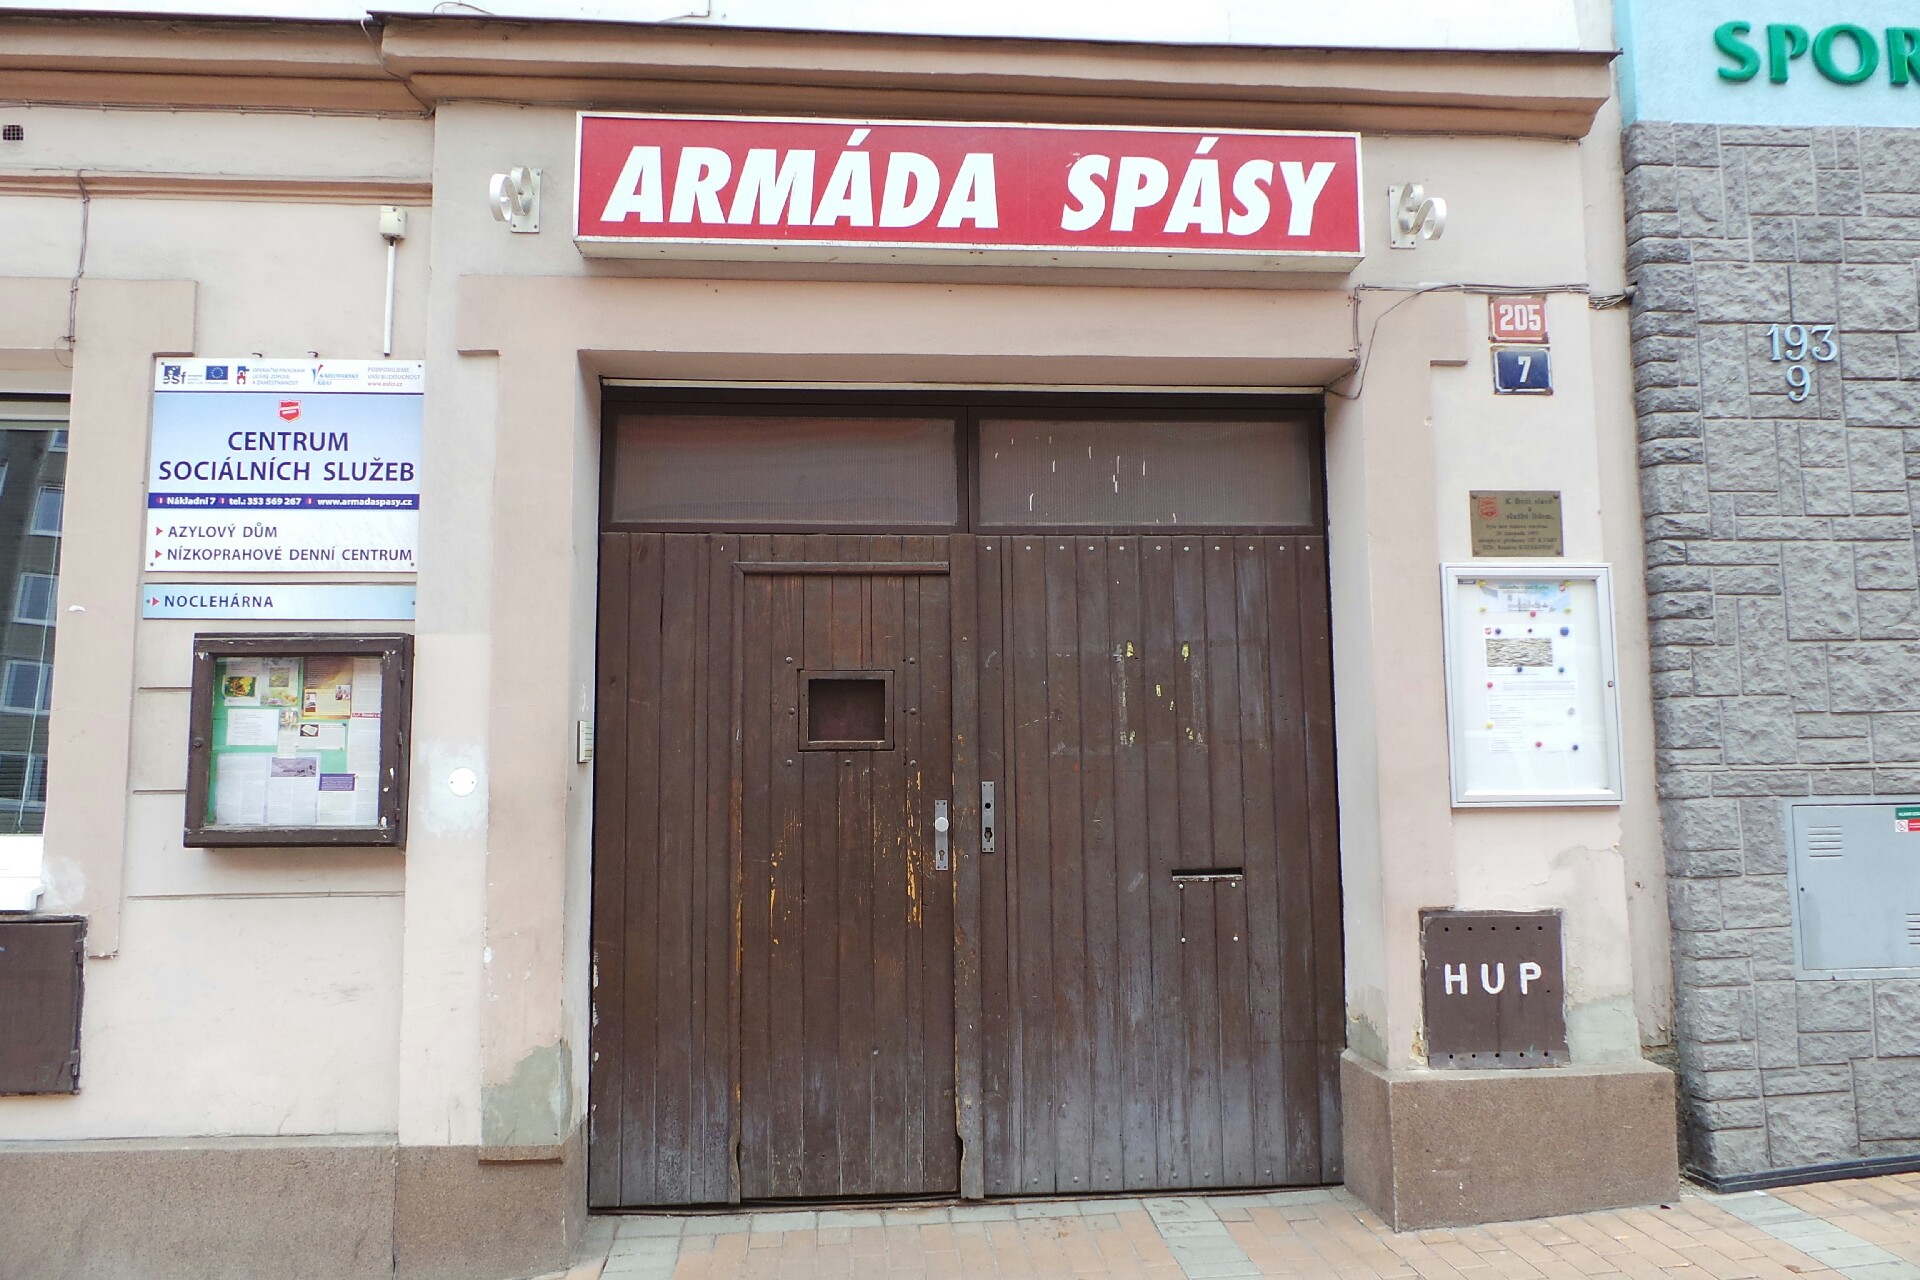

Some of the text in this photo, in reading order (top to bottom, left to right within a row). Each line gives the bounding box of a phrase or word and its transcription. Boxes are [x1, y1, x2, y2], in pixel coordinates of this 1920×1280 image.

[1714, 20, 1920, 85] SPOR
[601, 129, 1335, 237] ARMÁDA SPÁSY
[1499, 304, 1541, 331] 205
[1766, 323, 1838, 362] 193
[163, 372, 187, 385] esf
[1517, 355, 1532, 383] 7
[1784, 365, 1812, 402] 9
[228, 431, 349, 452] CENTRUM
[159, 457, 414, 481] SOCIÁLNÍCH SLUŽEB
[166, 496, 216, 505] Nákladní 7
[247, 497, 264, 505] 353
[265, 497, 283, 505] 569
[284, 497, 302, 505] 267
[317, 497, 413, 507] www.armadaspasy.cz
[168, 522, 277, 538] AZYLOVÝ DŮM
[167, 545, 412, 561] NÍZKOPRAHOVÉ DENNÍ CENTRUM
[164, 593, 274, 608] NOCLEHÁRNA
[1444, 962, 1542, 995] HUP
